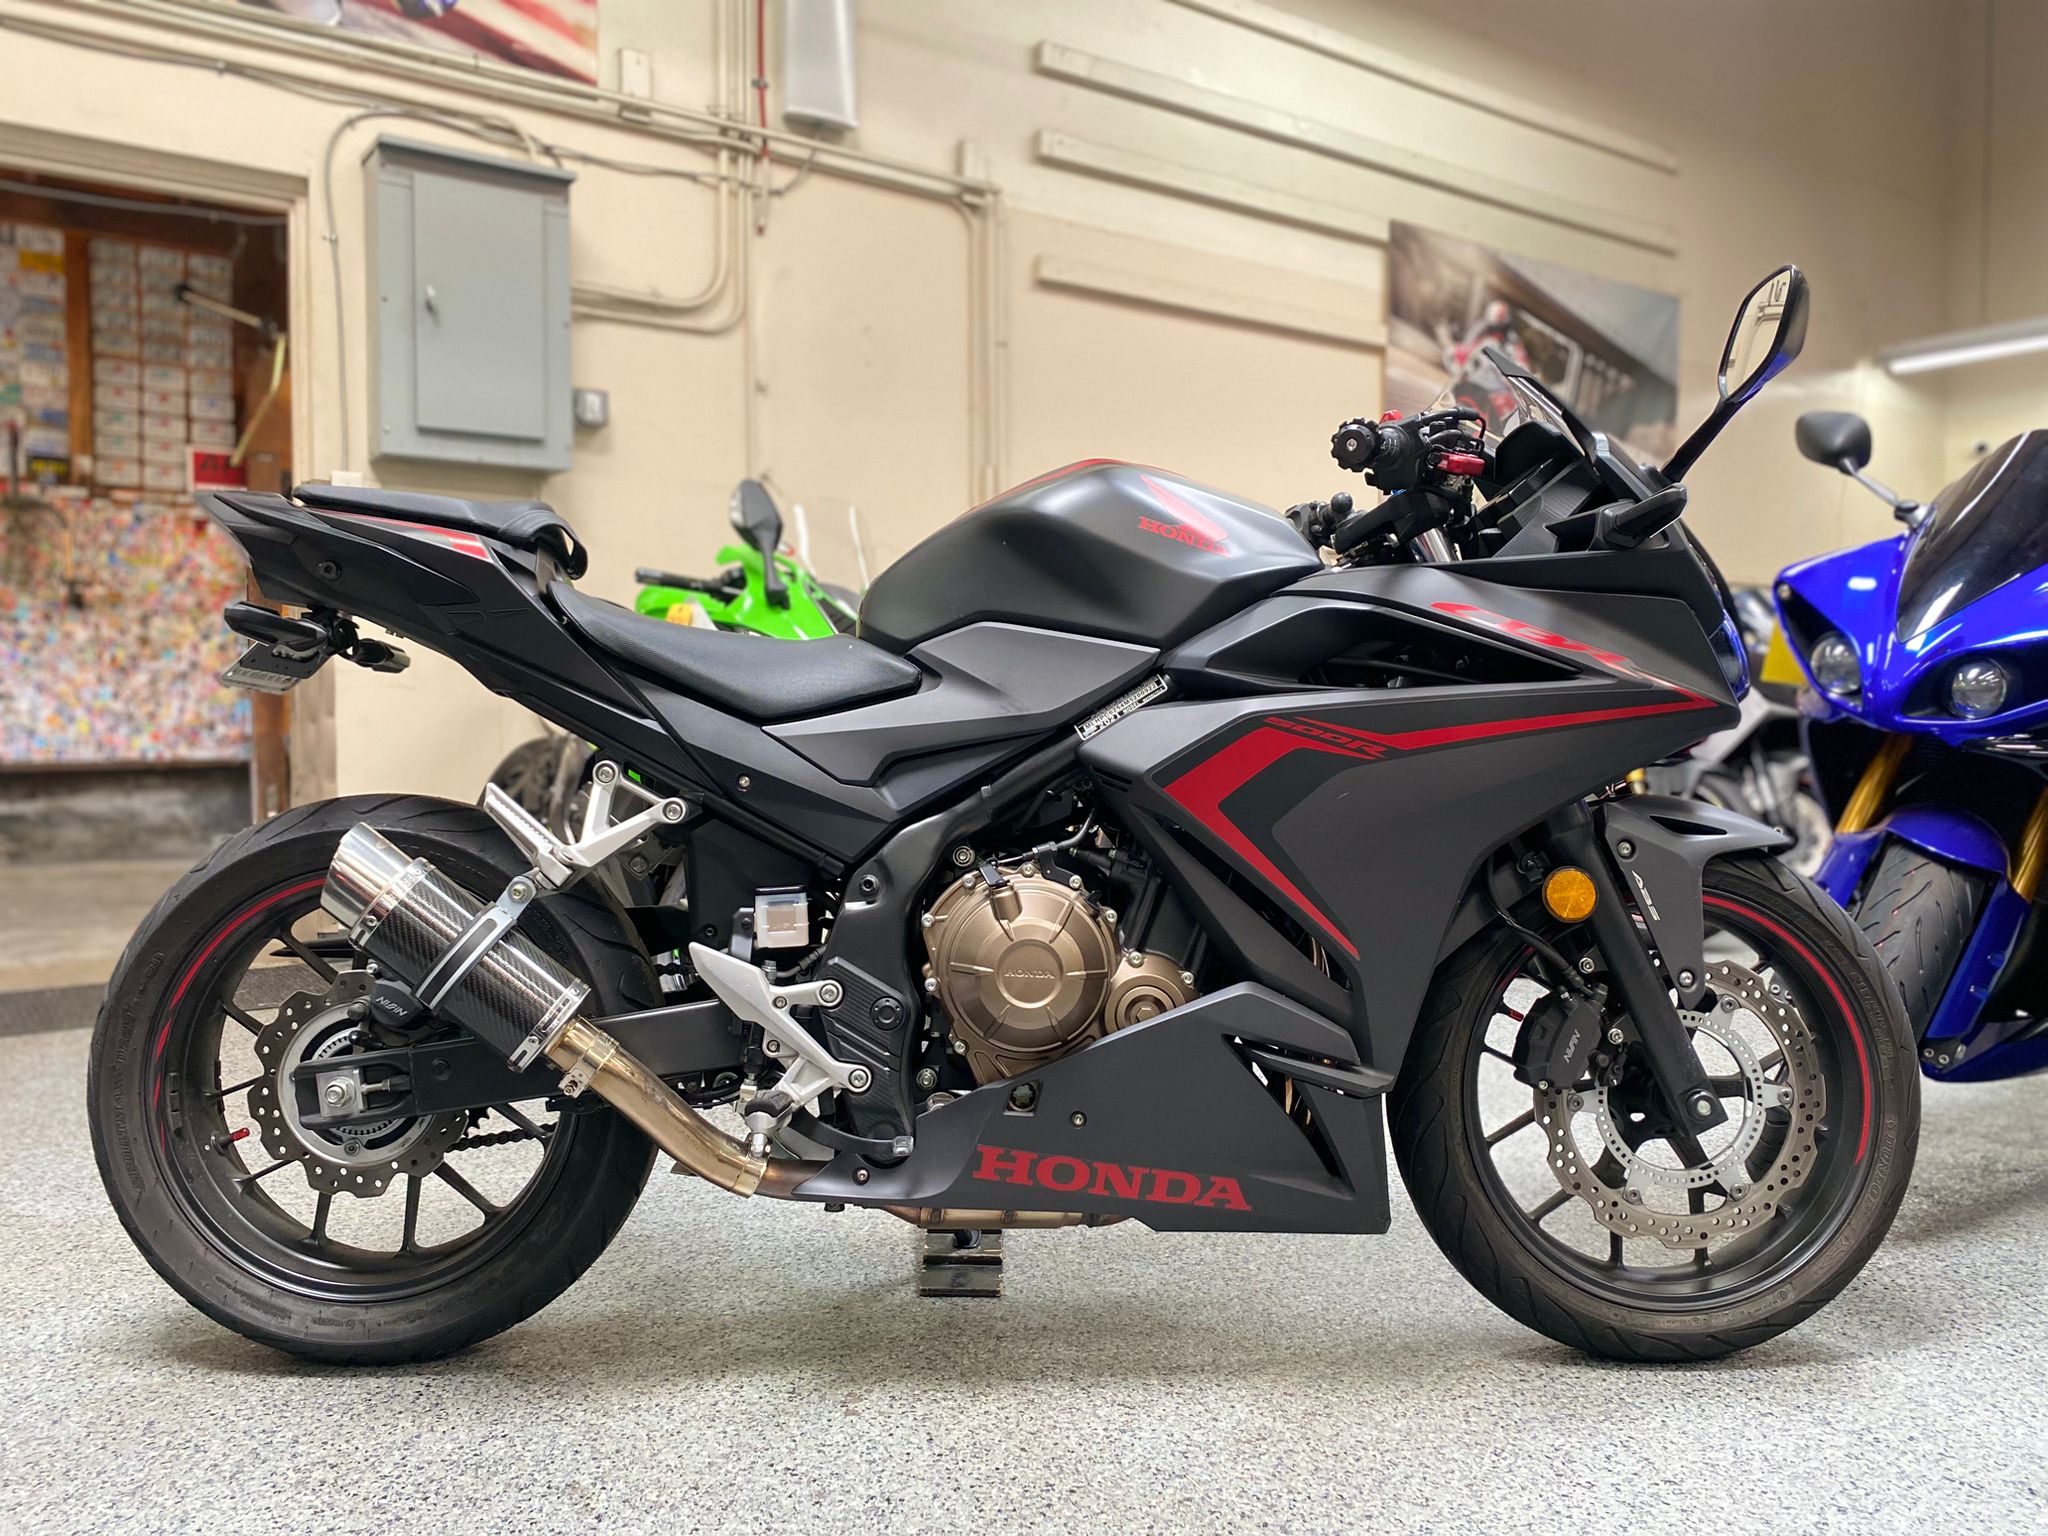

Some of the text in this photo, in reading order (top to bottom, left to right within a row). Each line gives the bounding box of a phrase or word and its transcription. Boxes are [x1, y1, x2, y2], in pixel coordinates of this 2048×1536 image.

[1262, 716, 1387, 759] 500R
[1004, 969, 1055, 979] HONDA
[972, 1144, 1252, 1211] HONDA
